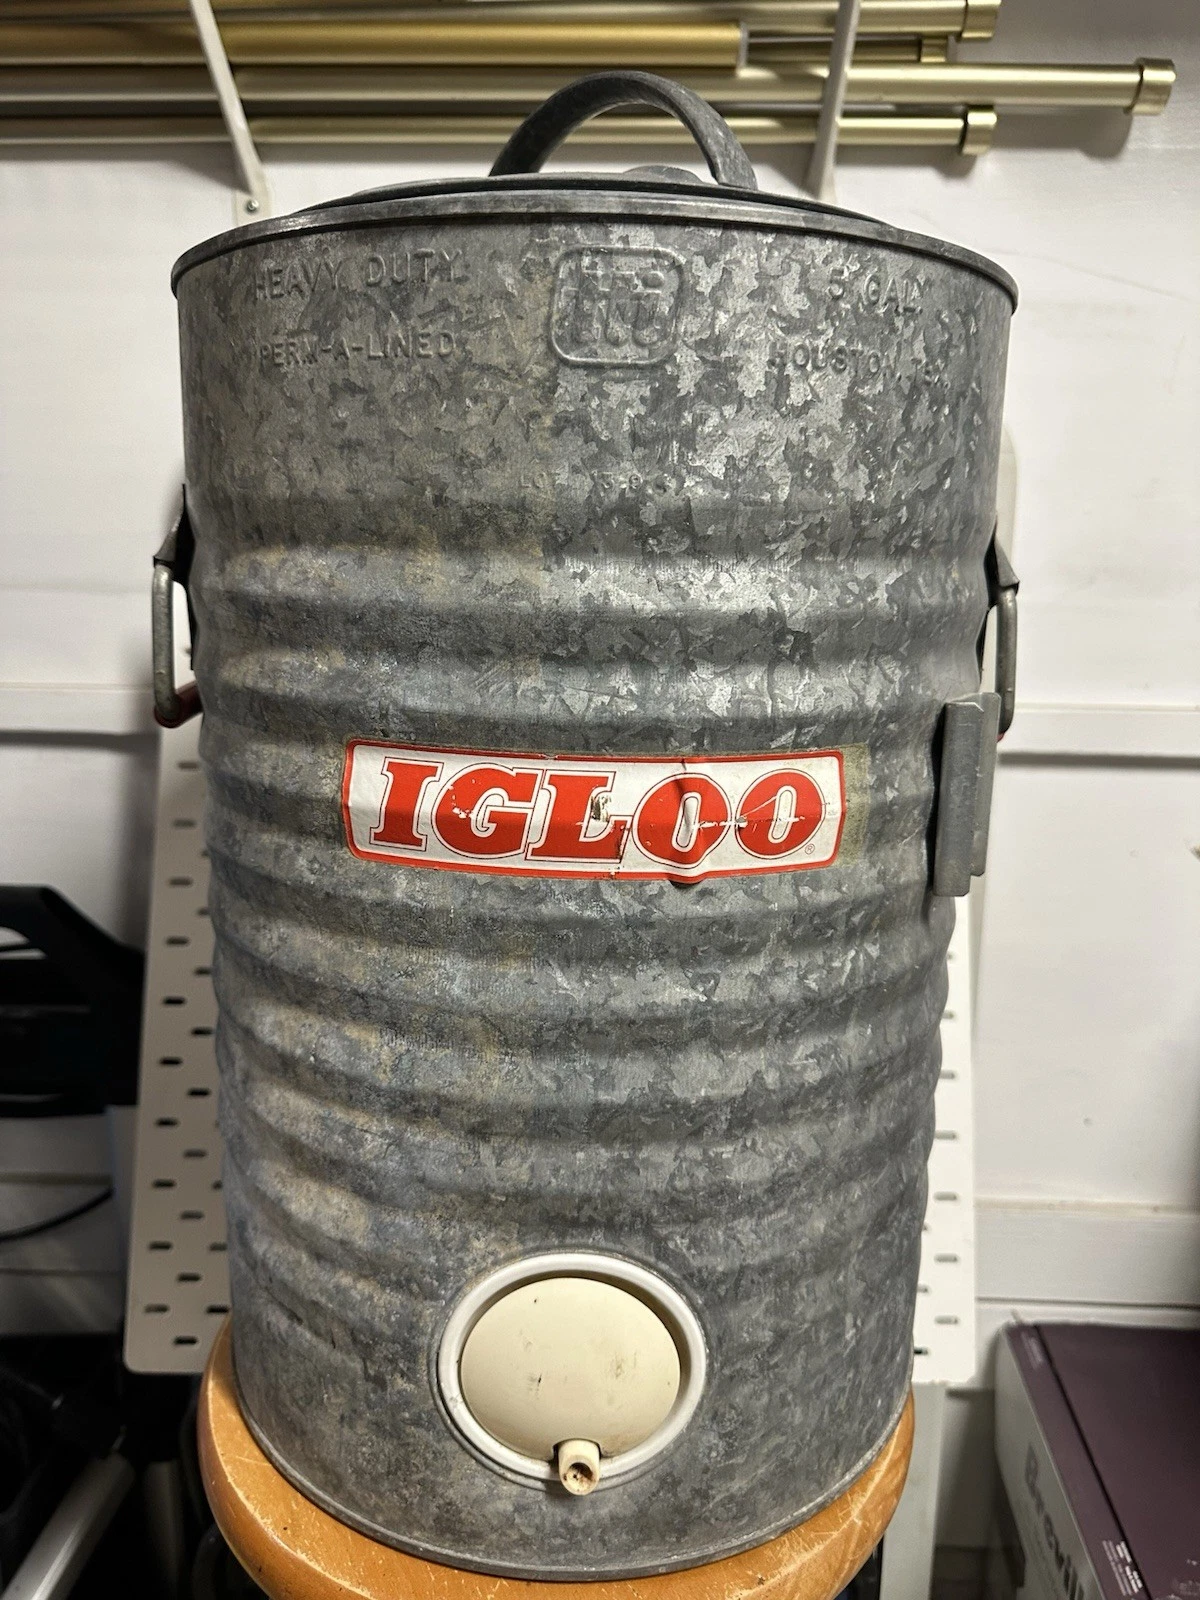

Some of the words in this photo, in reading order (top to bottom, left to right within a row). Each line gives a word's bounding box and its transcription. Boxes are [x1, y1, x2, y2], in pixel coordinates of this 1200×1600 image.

[254, 254, 346, 300] HEAVY
[366, 248, 464, 287] DUTY
[827, 267, 848, 299] 5
[260, 331, 457, 367] PERM-A-LINED
[368, 756, 827, 868] IGLOO
